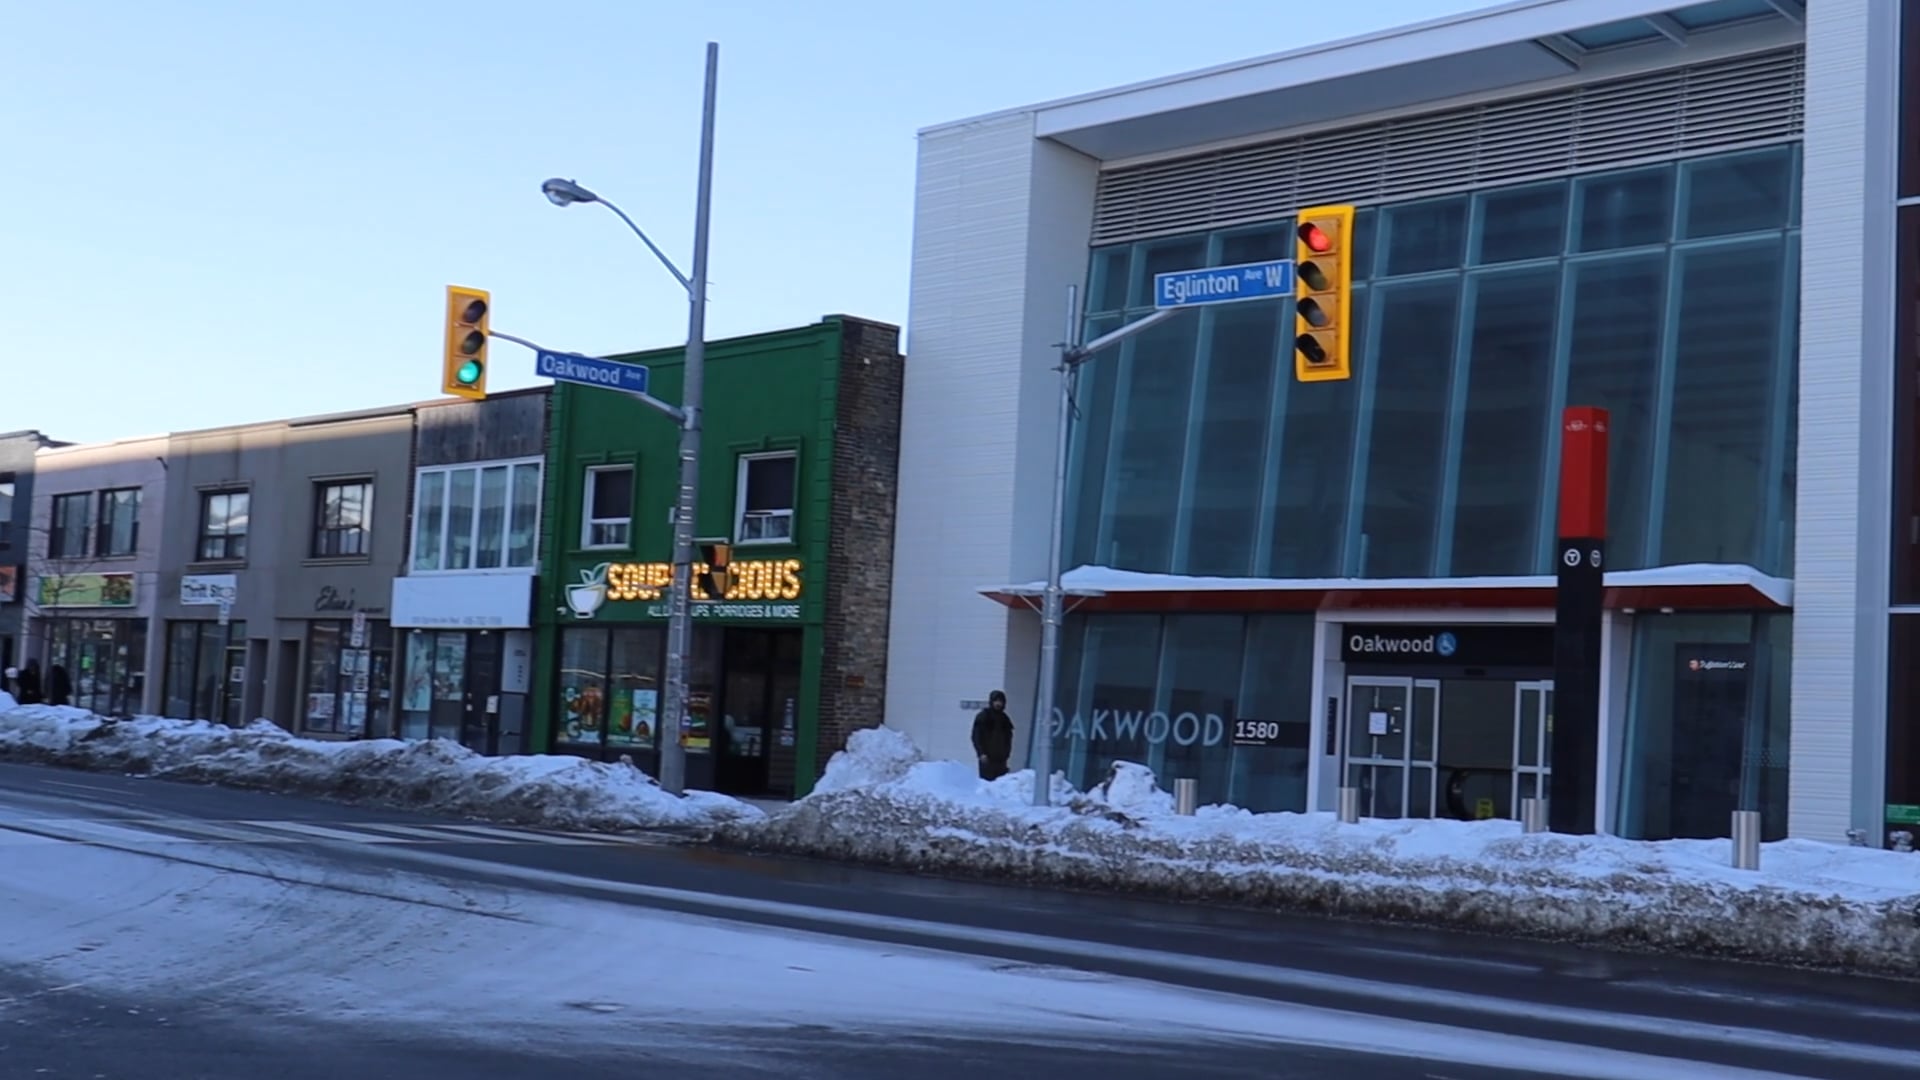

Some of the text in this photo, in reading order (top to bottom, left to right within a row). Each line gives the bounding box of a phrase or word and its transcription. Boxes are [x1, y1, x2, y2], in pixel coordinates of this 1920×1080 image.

[1163, 264, 1283, 303] Eglinton Ave W
[541, 354, 642, 385] Oakwood Ave
[713, 604, 764, 618] PORRIDGES
[772, 604, 800, 618] MORE
[1350, 634, 1434, 653] Oakwood
[1235, 720, 1279, 739] 1580
